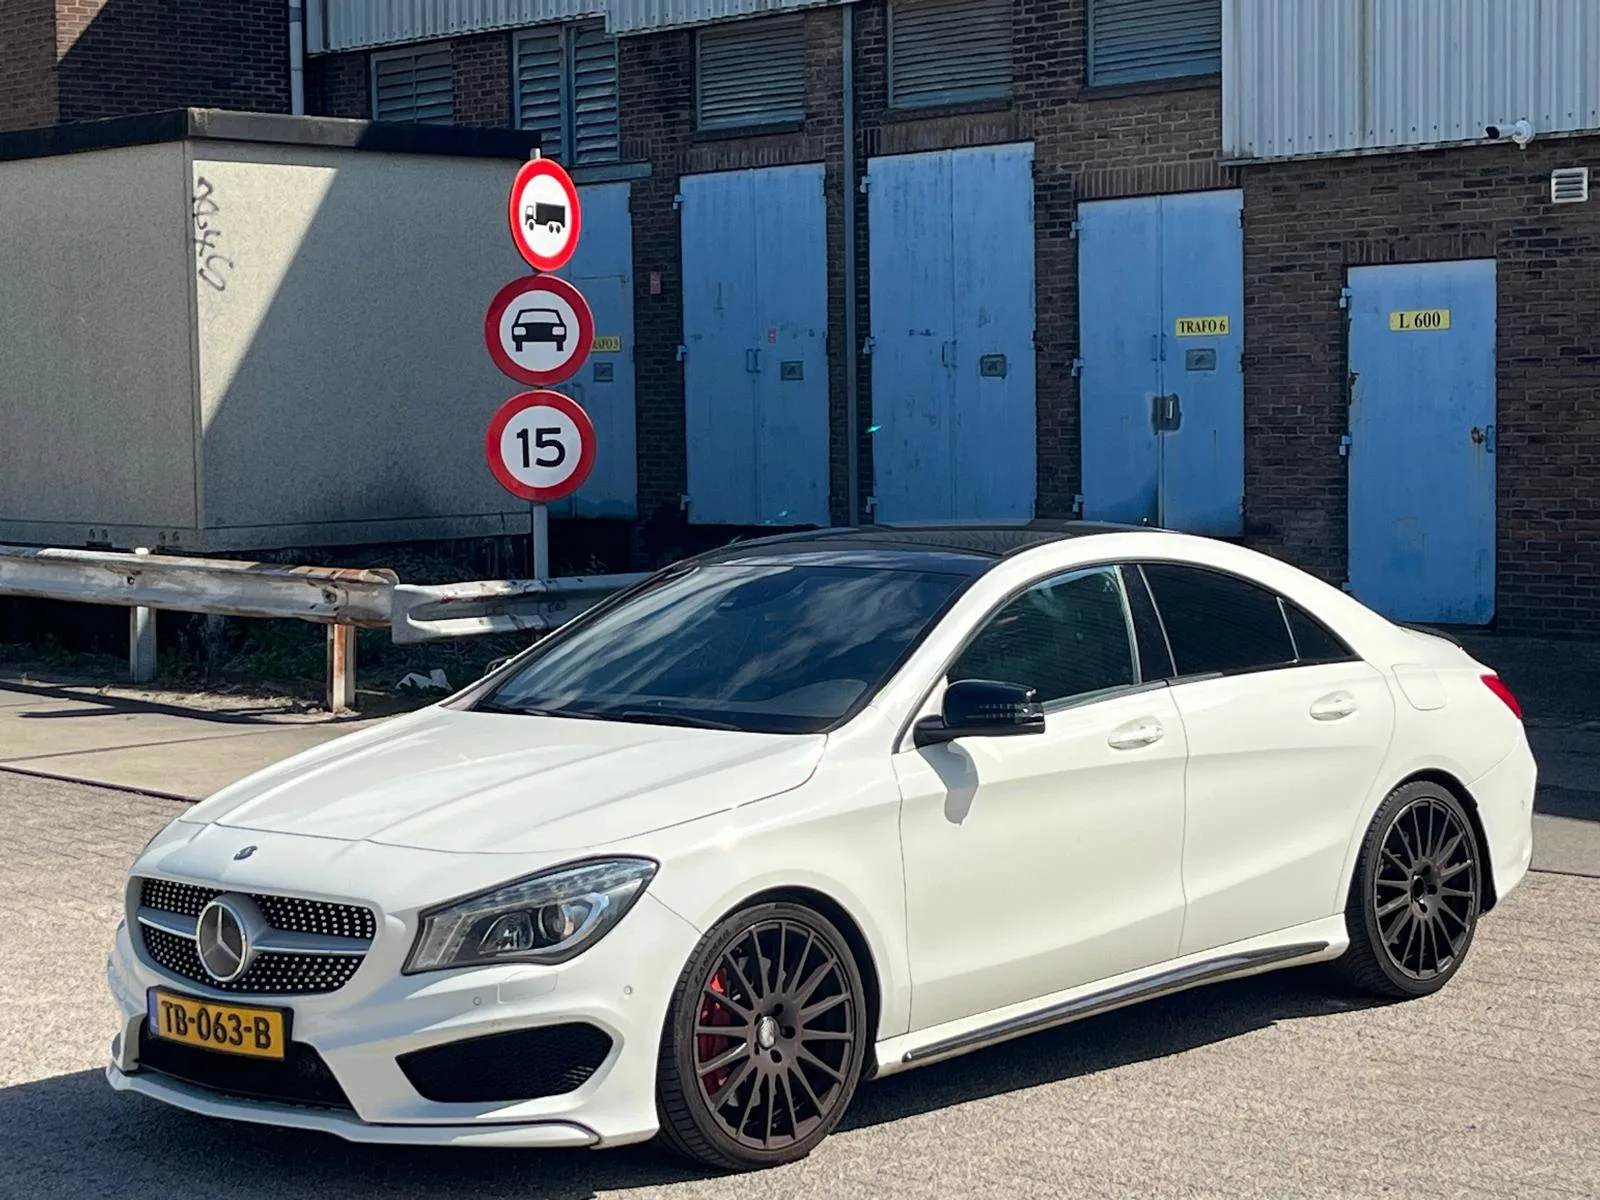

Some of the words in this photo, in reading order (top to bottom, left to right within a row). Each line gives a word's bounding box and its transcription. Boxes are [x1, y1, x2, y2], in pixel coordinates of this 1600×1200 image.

[1178, 319, 1217, 333] TRAFO
[1219, 319, 1226, 333] 6
[1399, 313, 1410, 329] L
[1414, 311, 1441, 328] 600
[516, 427, 566, 468] 15
[160, 1000, 272, 1050] TB-063-B
